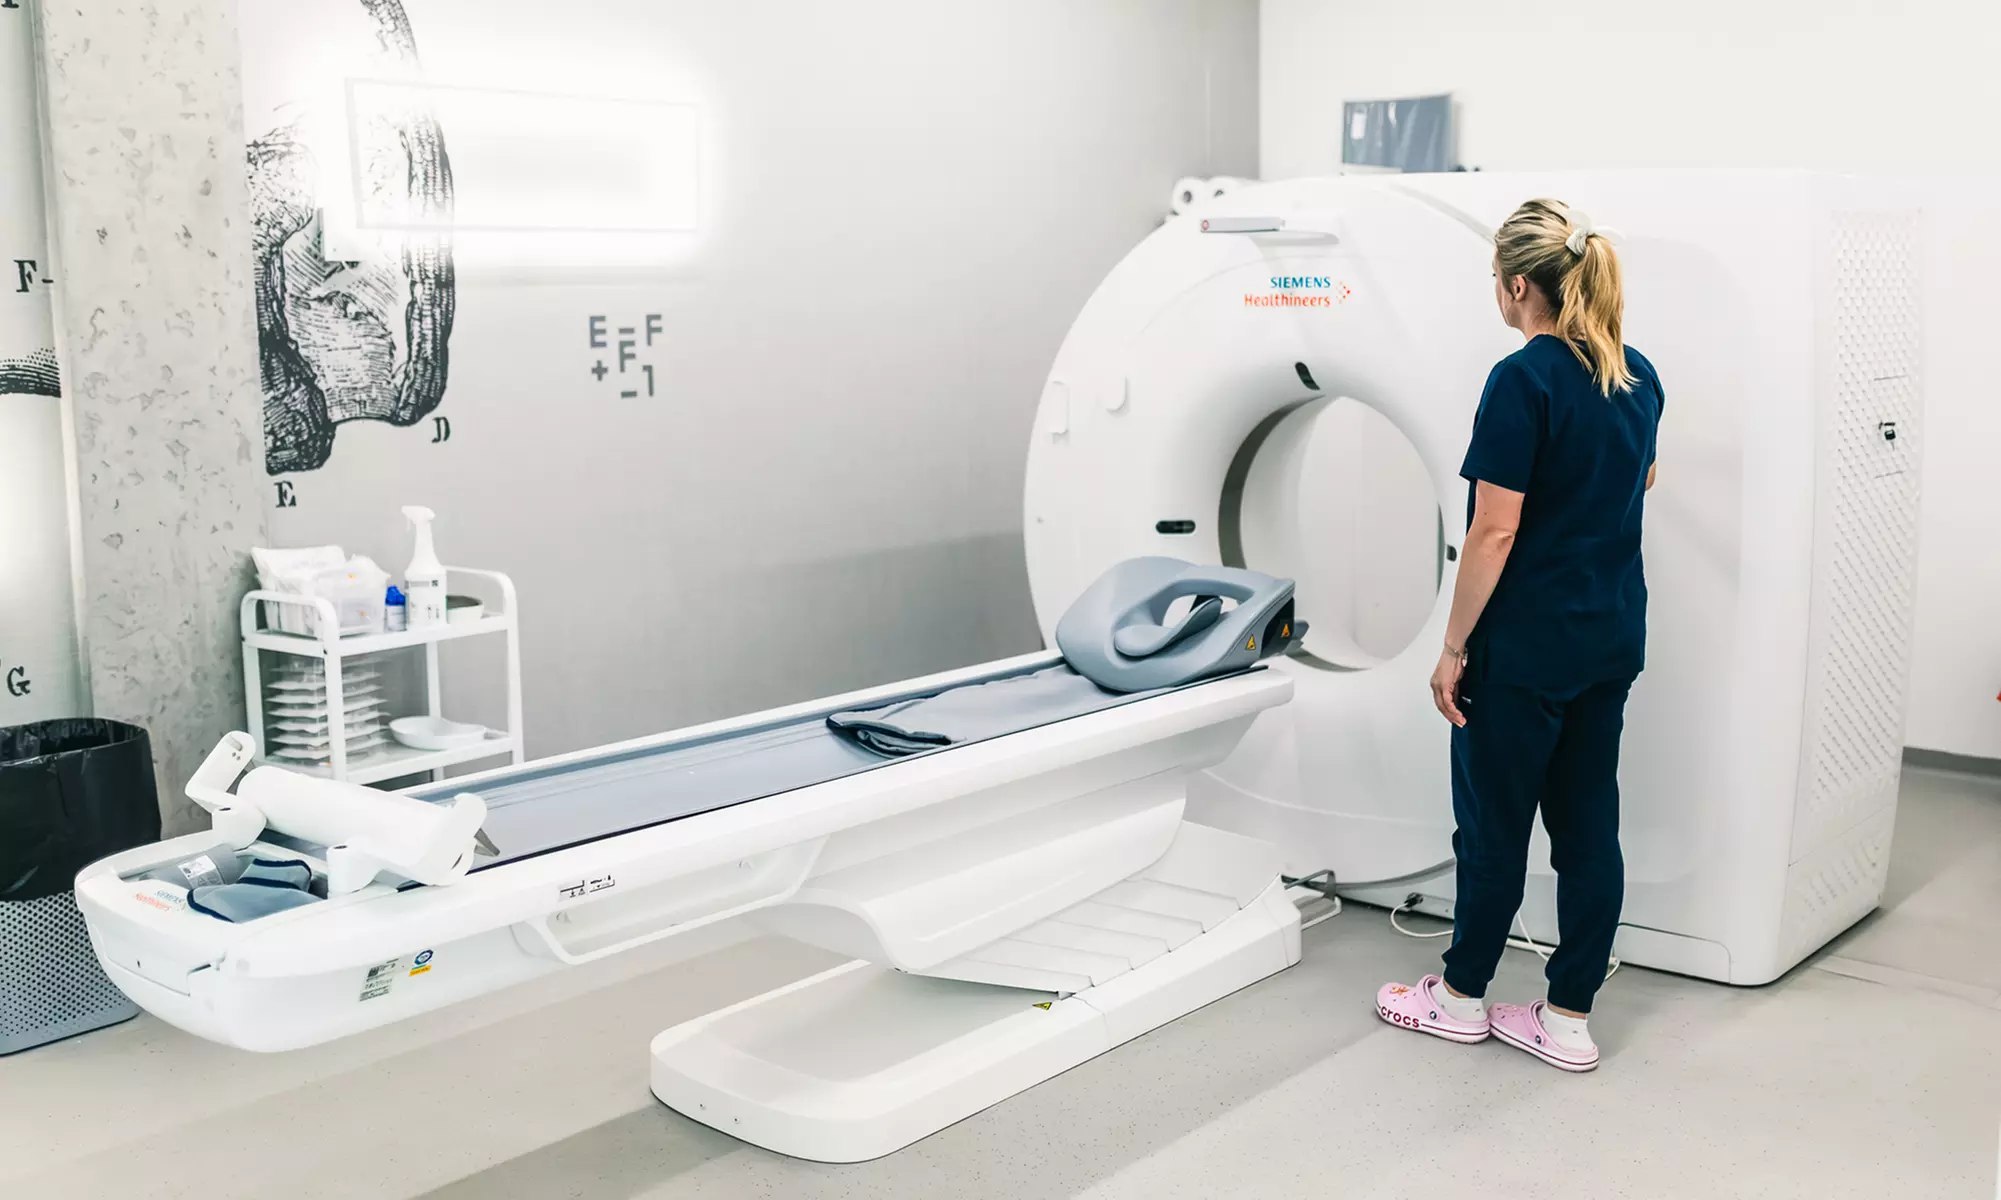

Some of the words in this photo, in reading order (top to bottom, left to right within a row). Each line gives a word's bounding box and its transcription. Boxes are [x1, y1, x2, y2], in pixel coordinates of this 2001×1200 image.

[1270, 276, 1331, 289] SIEMENS
[1244, 293, 1331, 307] Healthineers
[431, 416, 451, 444] D
[273, 480, 297, 508] E
[7, 665, 31, 697] G
[1380, 1006, 1420, 1028] crocs
